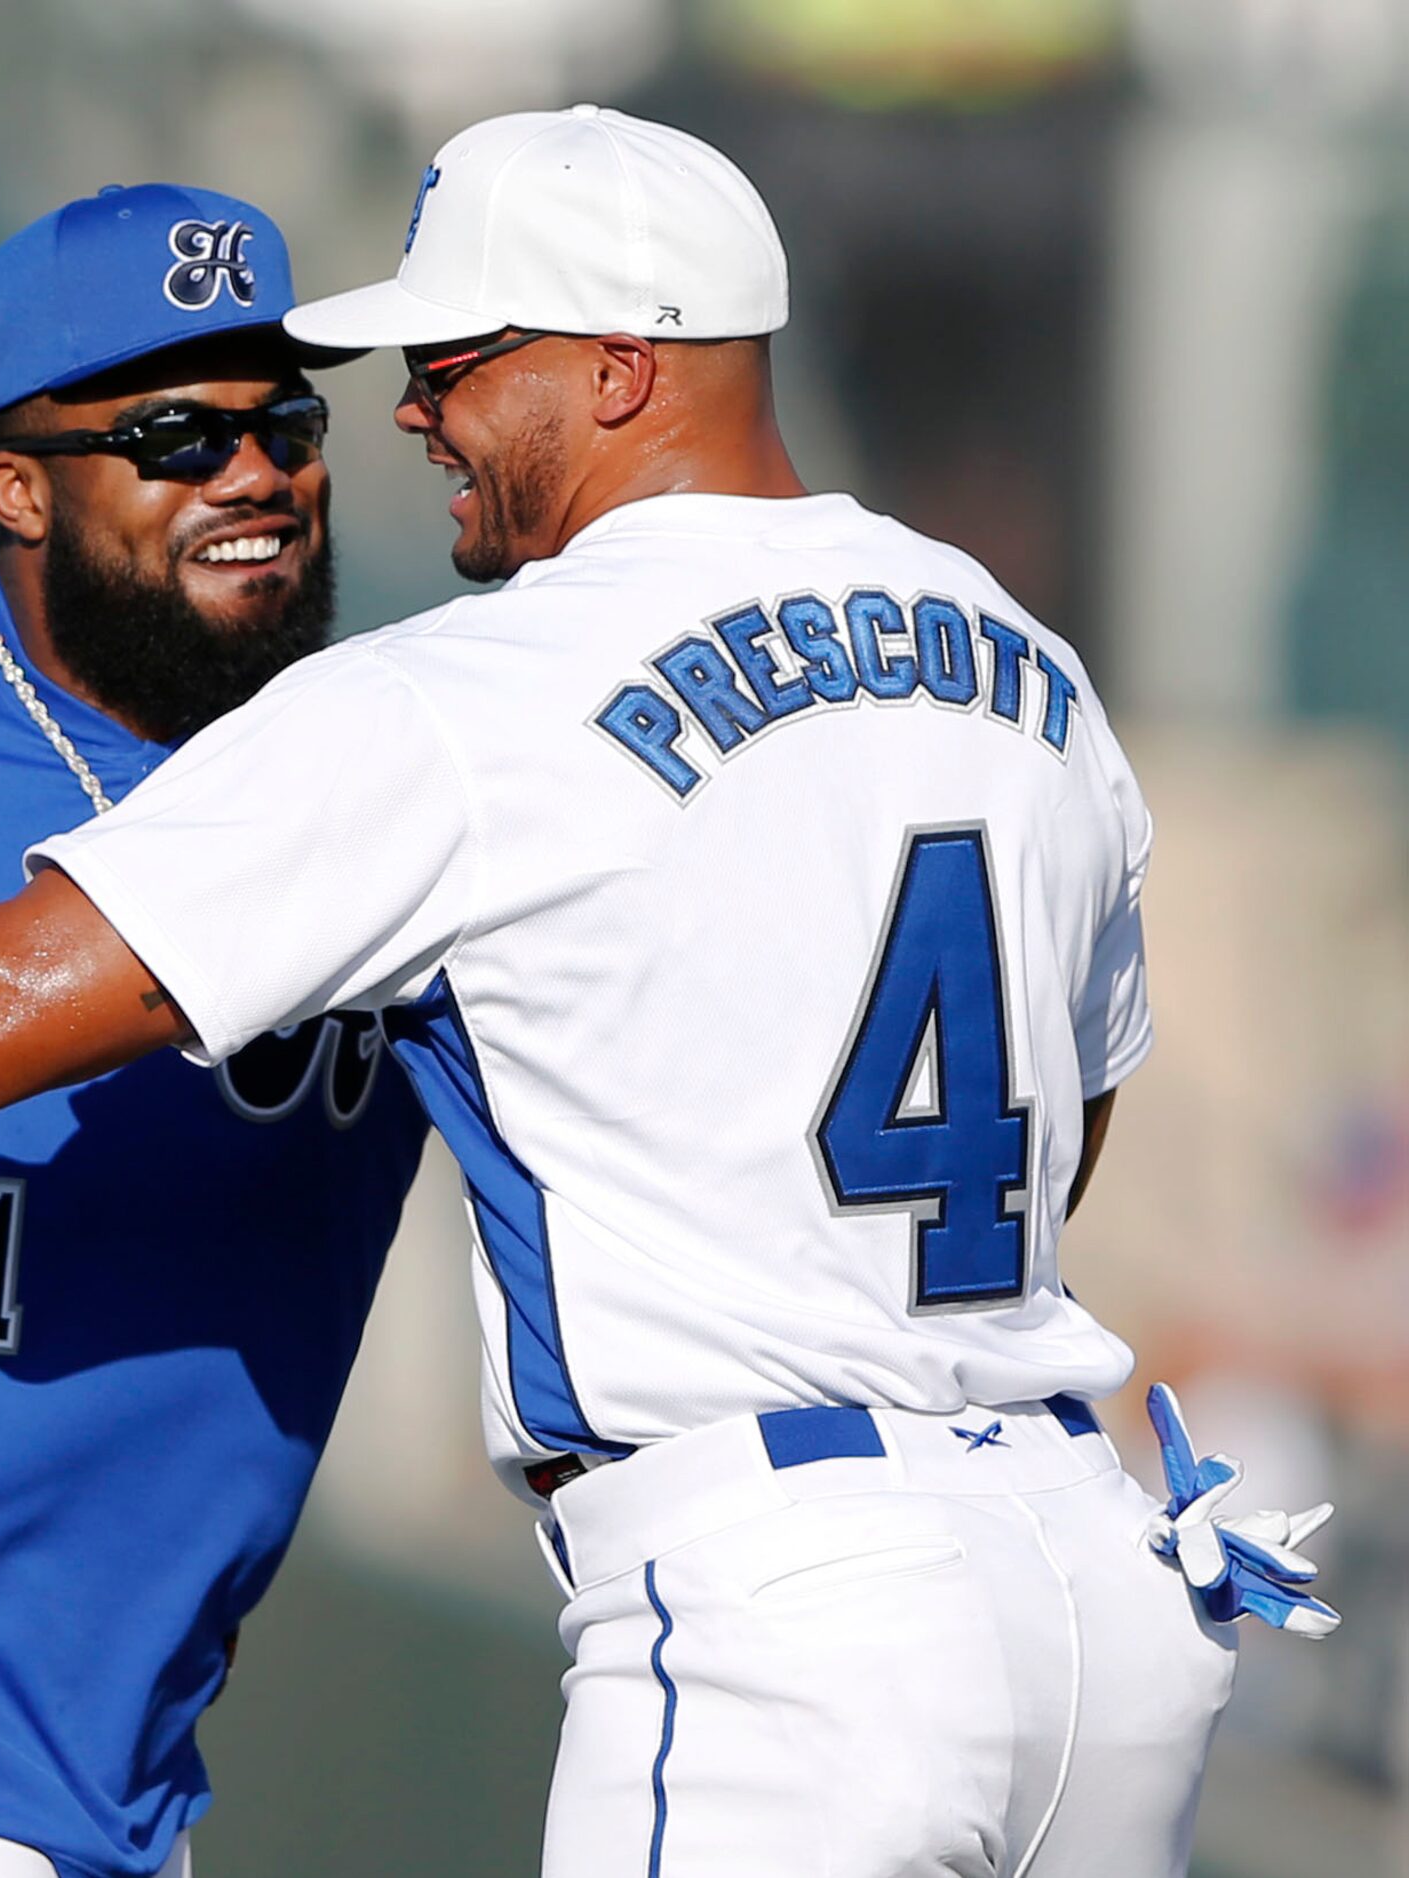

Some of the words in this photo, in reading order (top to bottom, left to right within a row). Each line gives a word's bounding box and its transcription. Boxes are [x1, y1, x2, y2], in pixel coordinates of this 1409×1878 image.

[656, 305, 683, 326] R
[584, 584, 1081, 808] PRESCOTT
[805, 818, 1036, 1317] 4
